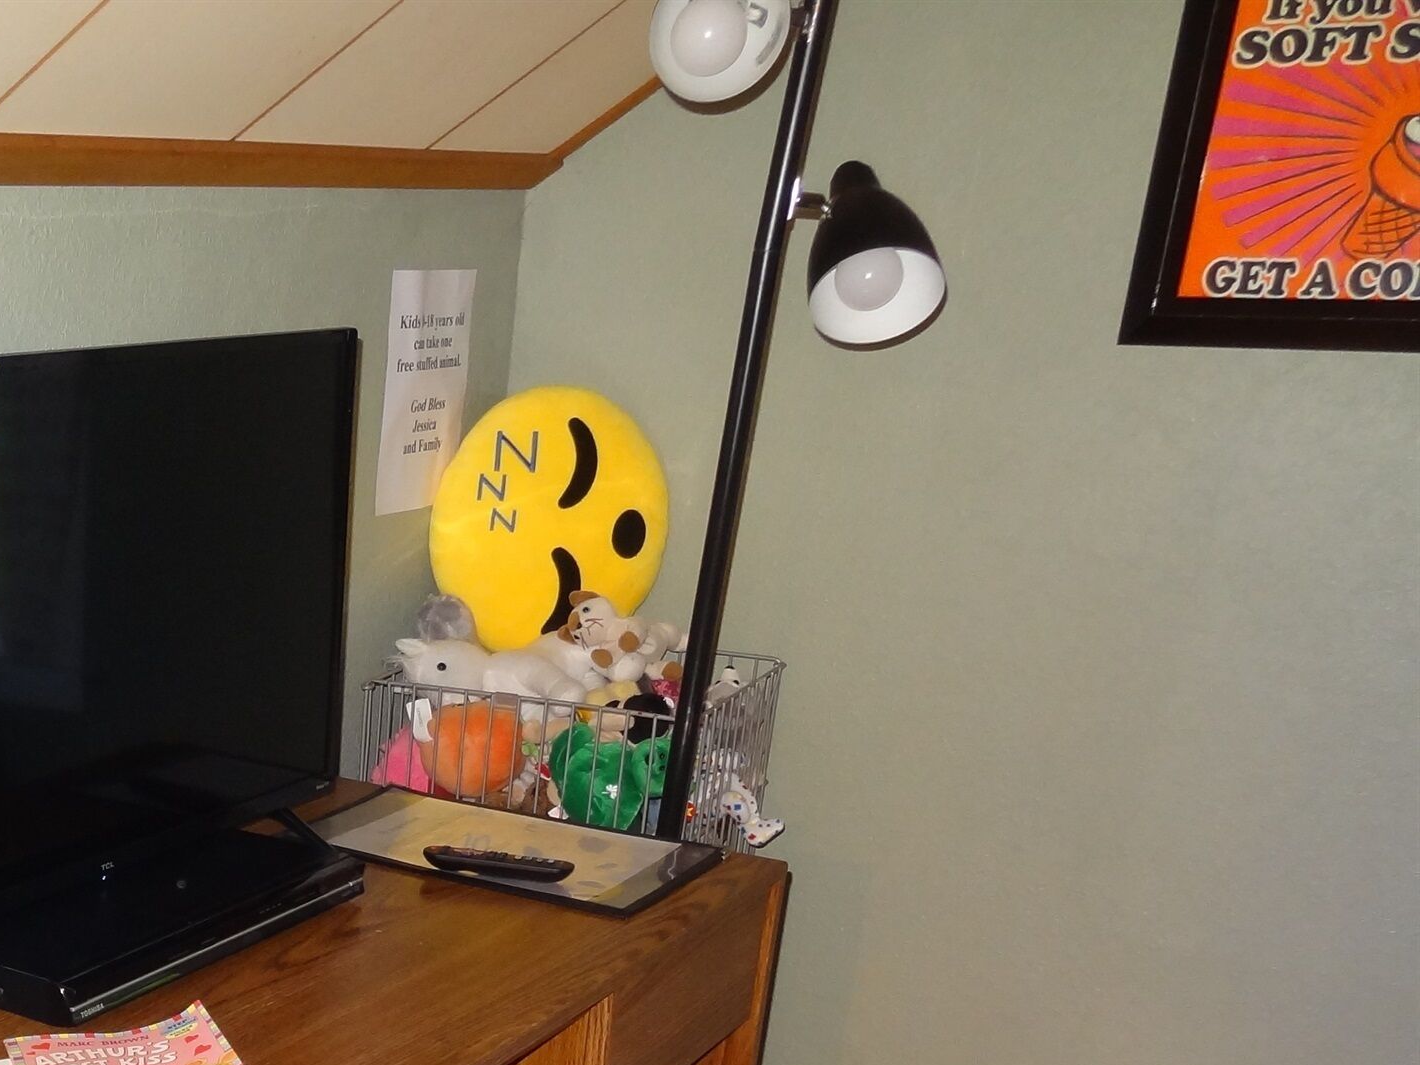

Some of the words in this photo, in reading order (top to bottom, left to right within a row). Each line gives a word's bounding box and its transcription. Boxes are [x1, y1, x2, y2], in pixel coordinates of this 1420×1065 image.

[1234, 24, 1383, 66] SOFT
[1205, 259, 1298, 296] GET
[1298, 260, 1338, 297] A
[400, 314, 421, 329] Kids
[435, 316, 453, 331] years
[455, 312, 465, 326] old
[413, 339, 425, 350] can
[426, 335, 440, 349] take
[441, 337, 453, 347] one
[396, 358, 414, 373] free
[416, 356, 438, 371] stuffed
[411, 398, 427, 413] God
[428, 397, 446, 411] Bless
[412, 418, 437, 433] Jessica
[403, 440, 417, 455] and
[418, 436, 441, 453] Family
[100, 861, 115, 871] TCL
[101, 1035, 150, 1046] BROWN
